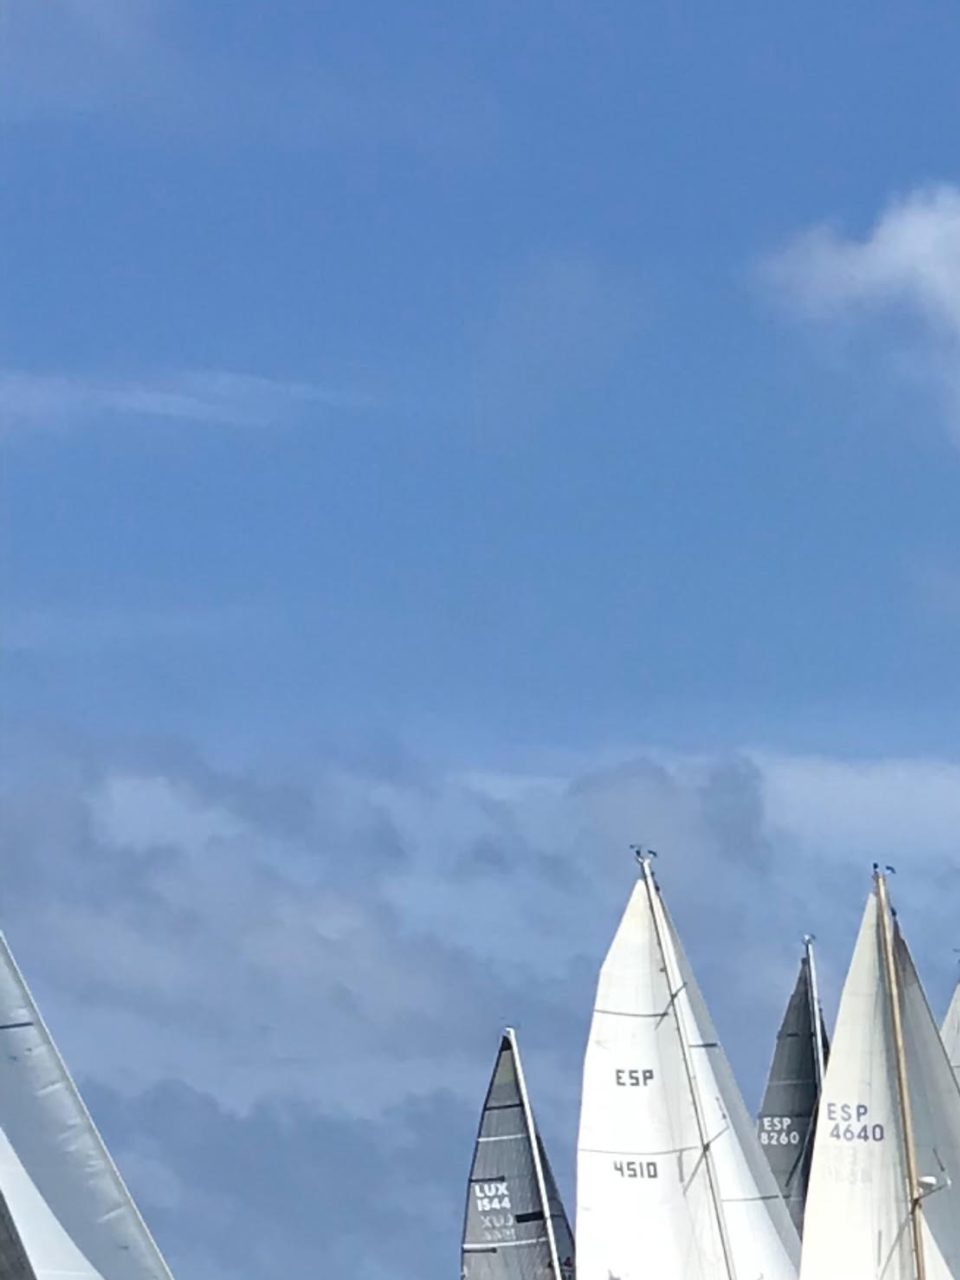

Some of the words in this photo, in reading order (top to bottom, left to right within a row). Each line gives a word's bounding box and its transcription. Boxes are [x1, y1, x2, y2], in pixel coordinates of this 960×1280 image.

[616, 1069, 654, 1087] ESP
[827, 1102, 868, 1122] ESP
[763, 1116, 792, 1131] ESP
[760, 1130, 800, 1145] 8260
[829, 1122, 885, 1143] 4640
[613, 1161, 658, 1179] 4510
[474, 1182, 509, 1198] LUX
[477, 1196, 512, 1212] 1544
